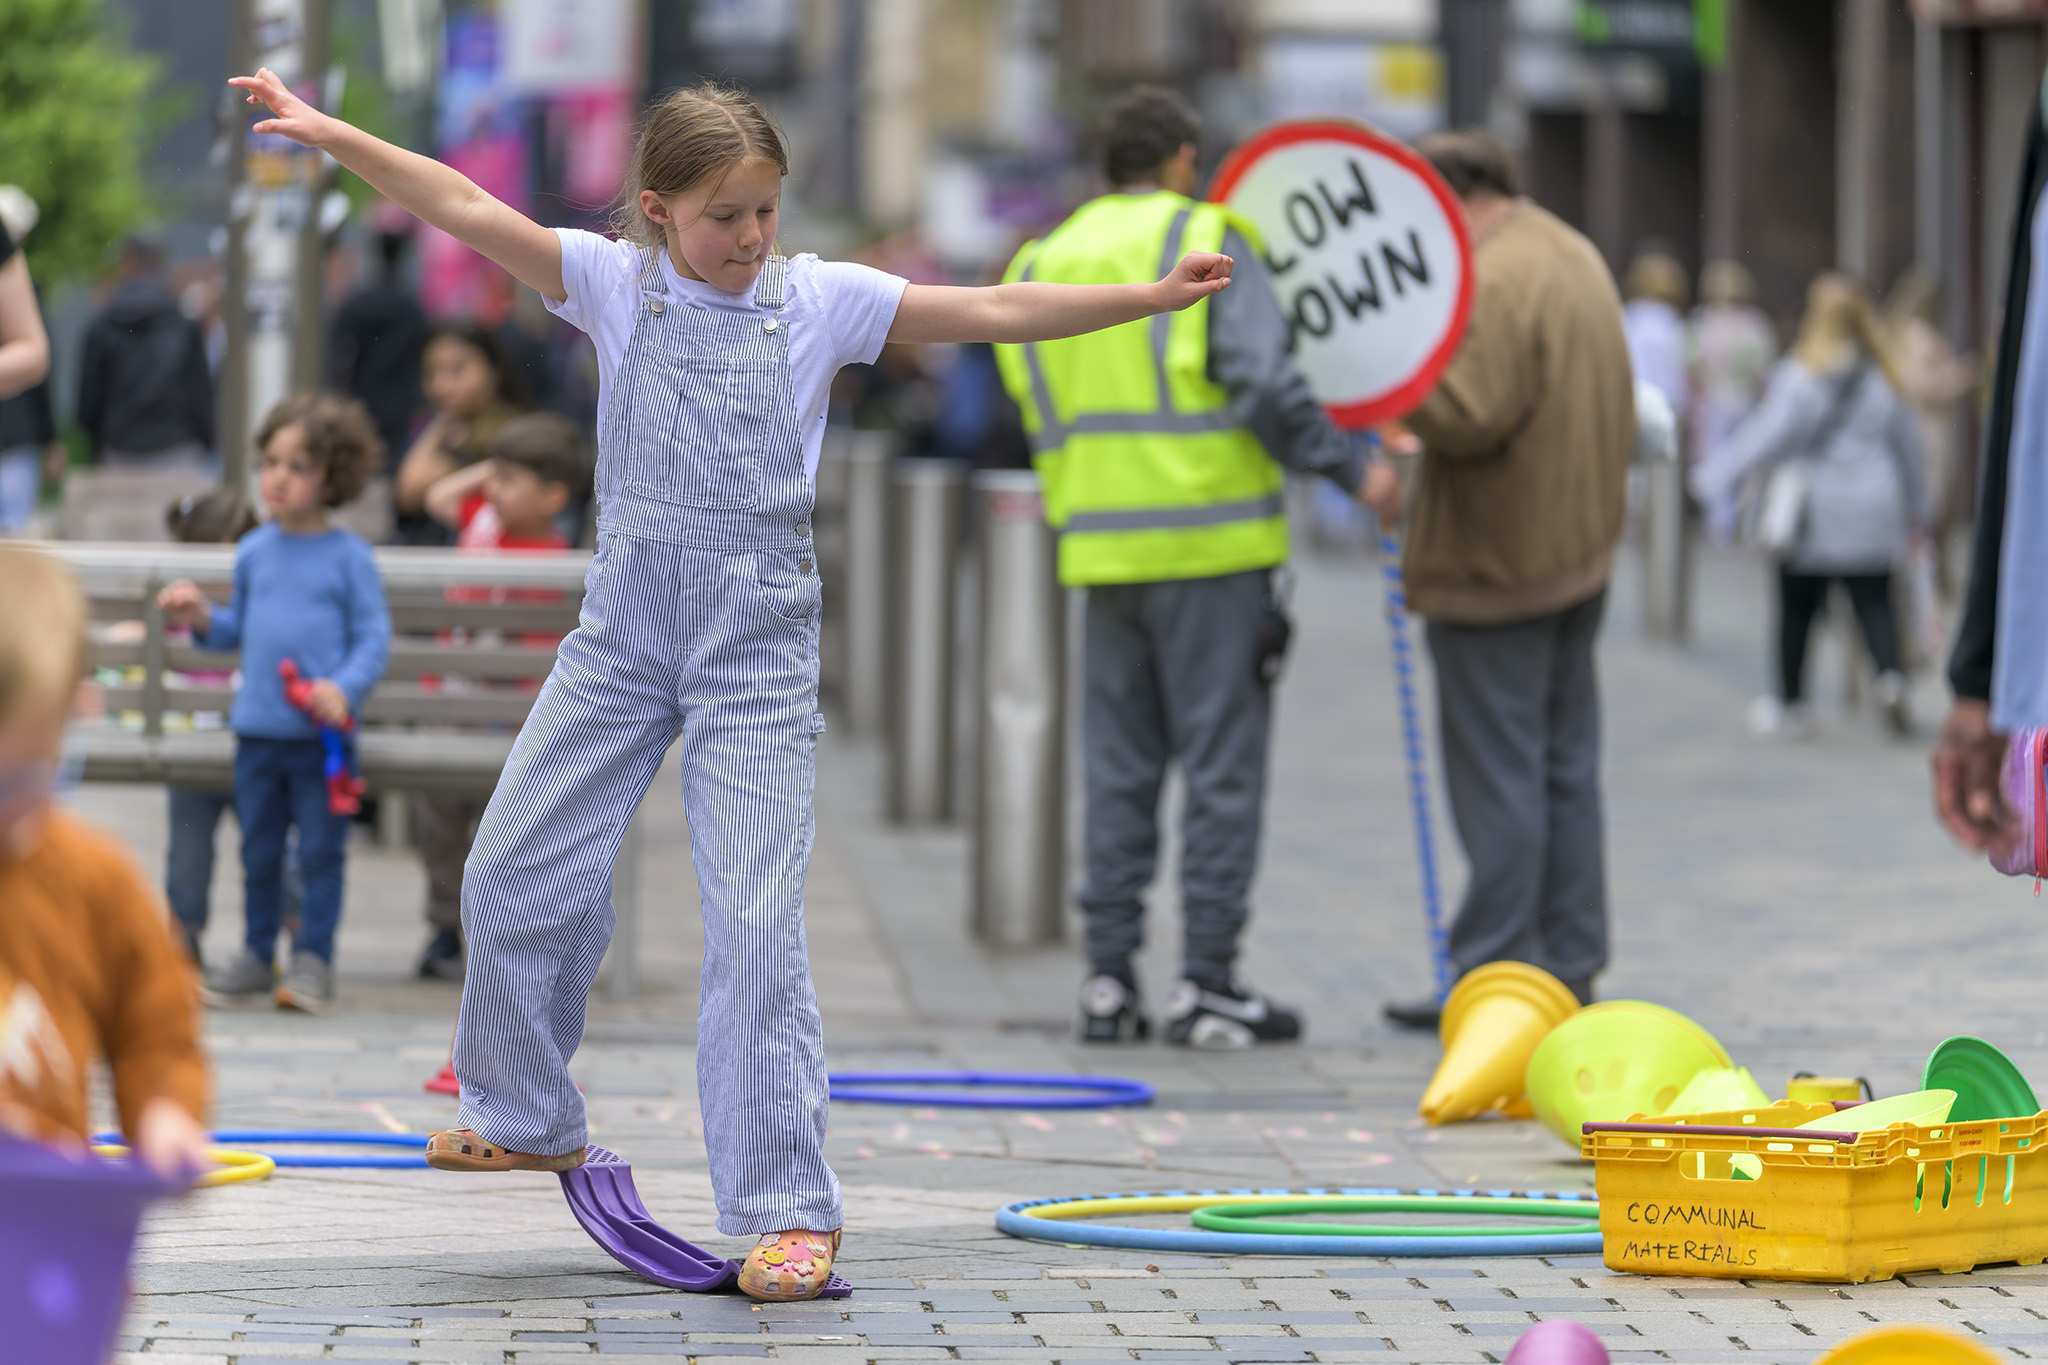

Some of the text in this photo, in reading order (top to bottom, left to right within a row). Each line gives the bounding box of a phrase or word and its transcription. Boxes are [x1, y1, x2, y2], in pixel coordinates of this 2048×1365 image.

[1264, 156, 1378, 277] LOW
[1627, 1201, 1766, 1231] COMMUNAL
[1622, 1239, 1757, 1266] MATERIALS
